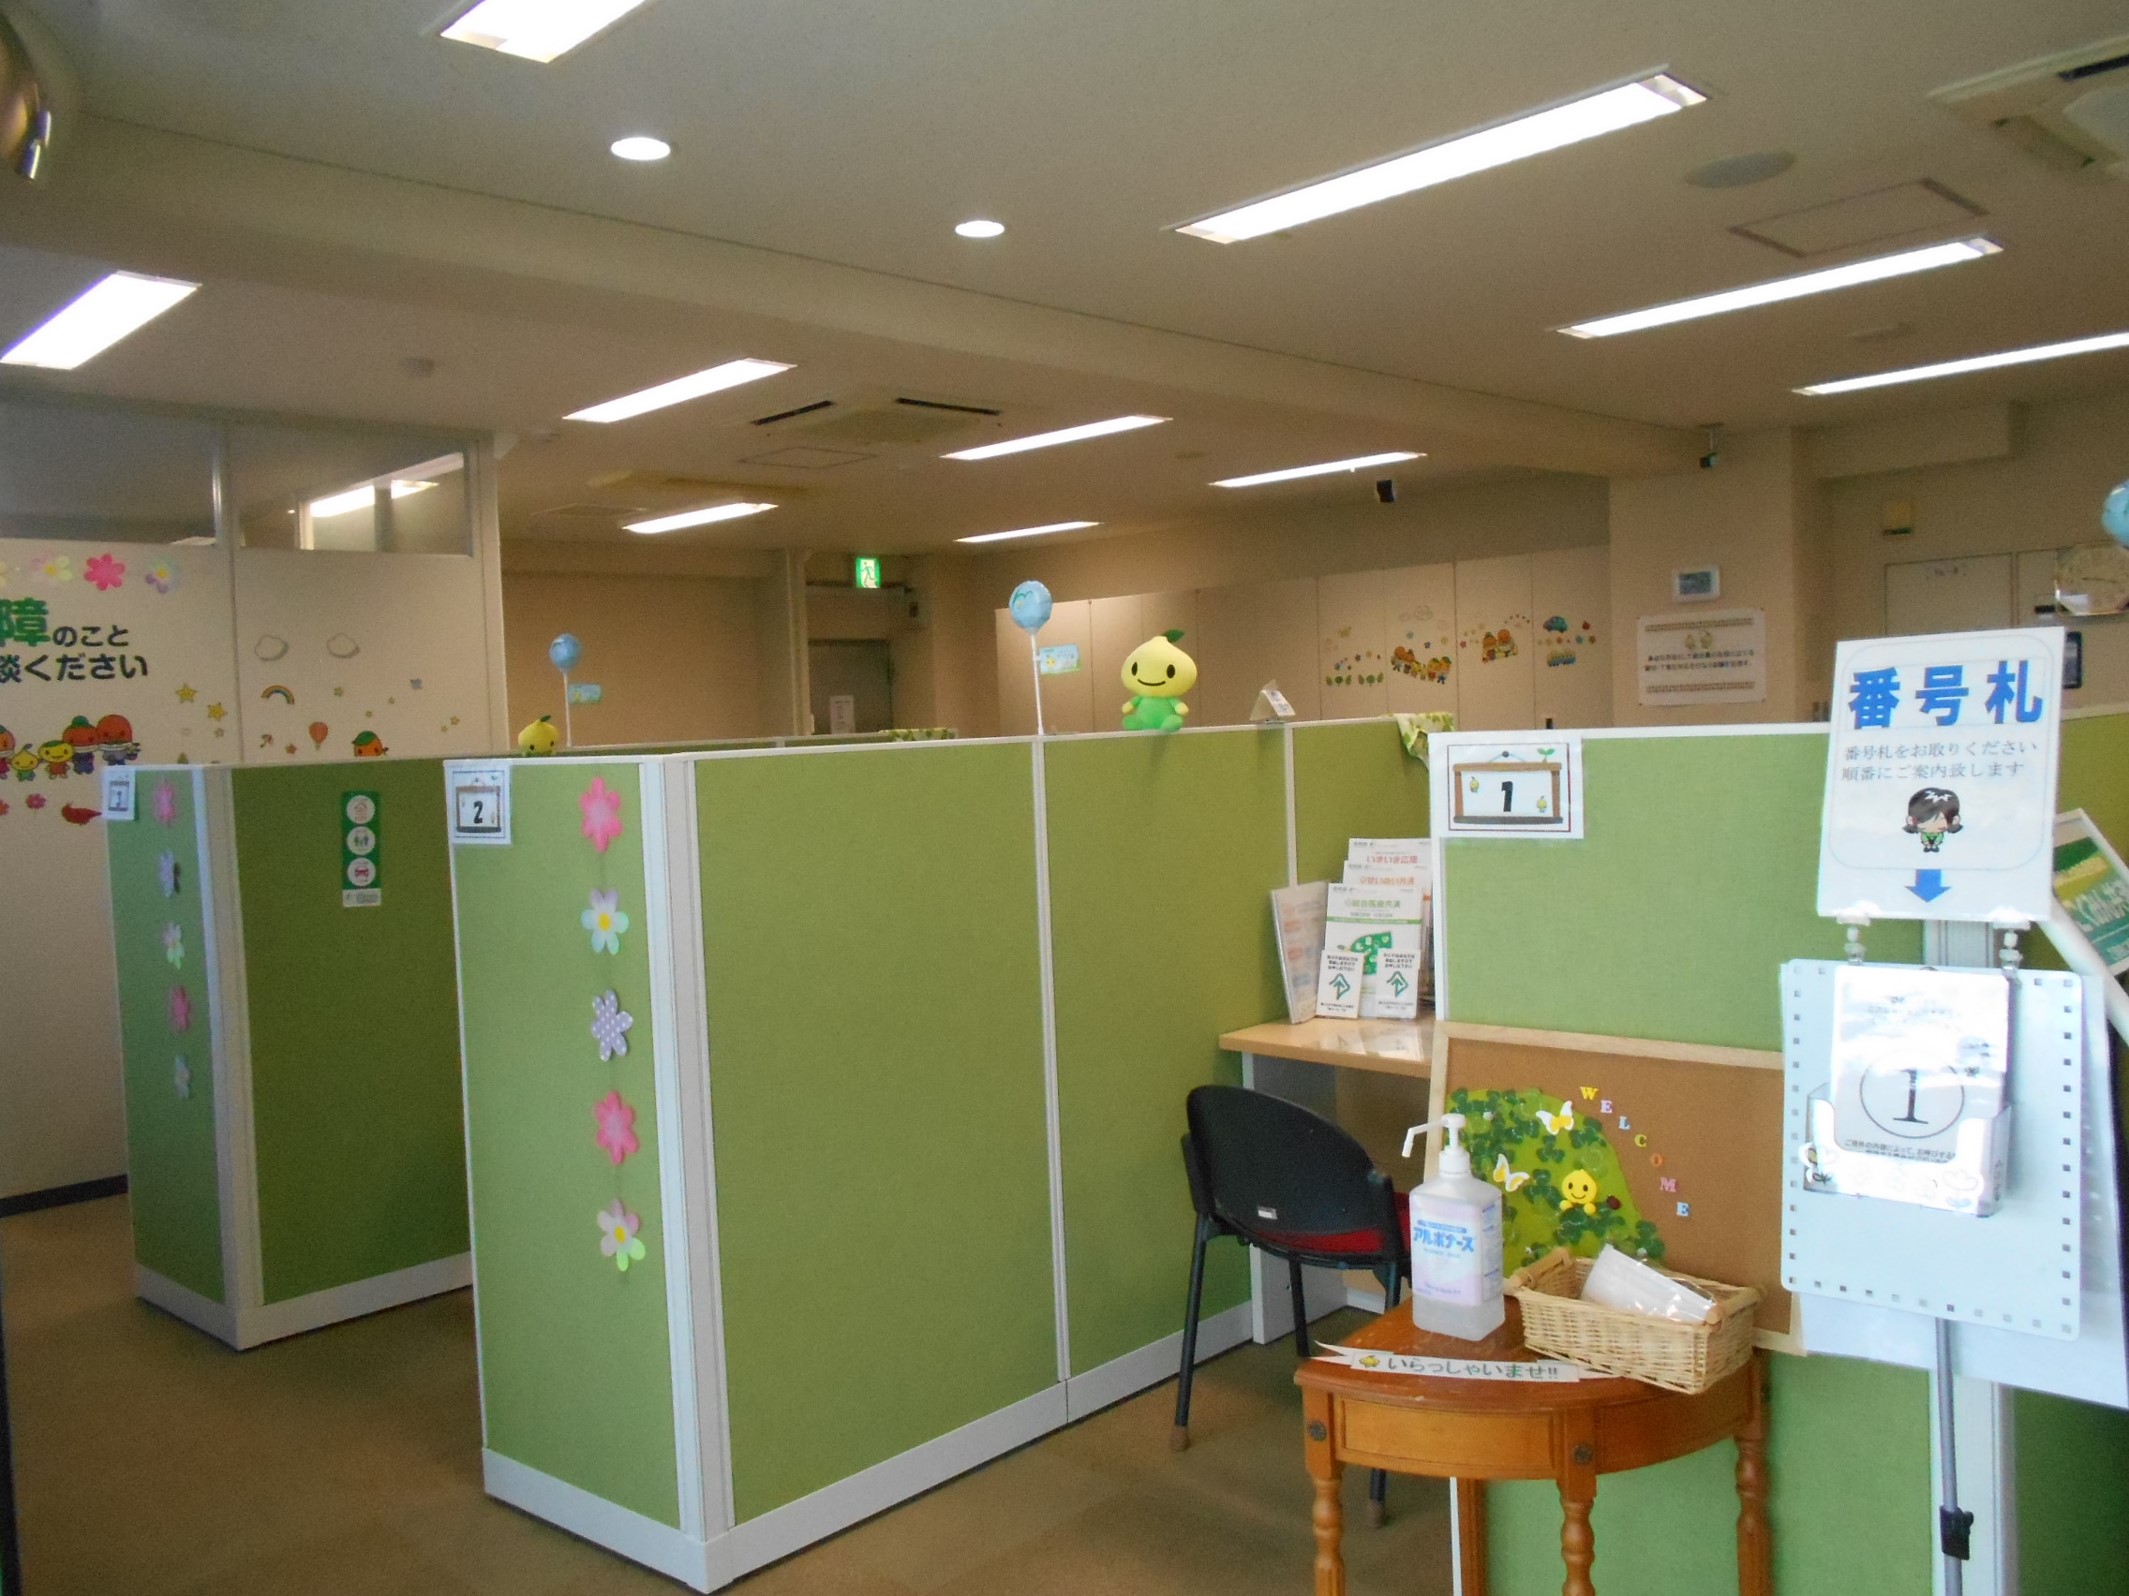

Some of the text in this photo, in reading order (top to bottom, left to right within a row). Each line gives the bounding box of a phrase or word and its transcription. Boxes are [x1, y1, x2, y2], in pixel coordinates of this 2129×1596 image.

[1848, 660, 2043, 729] 番号札
[1845, 740, 2038, 761] 番号札をお取りください
[1841, 761, 2025, 782] 順番にご案内致します
[1500, 780, 1514, 812] 1
[473, 800, 483, 824] 2
[1893, 1068, 1929, 1125] 1
